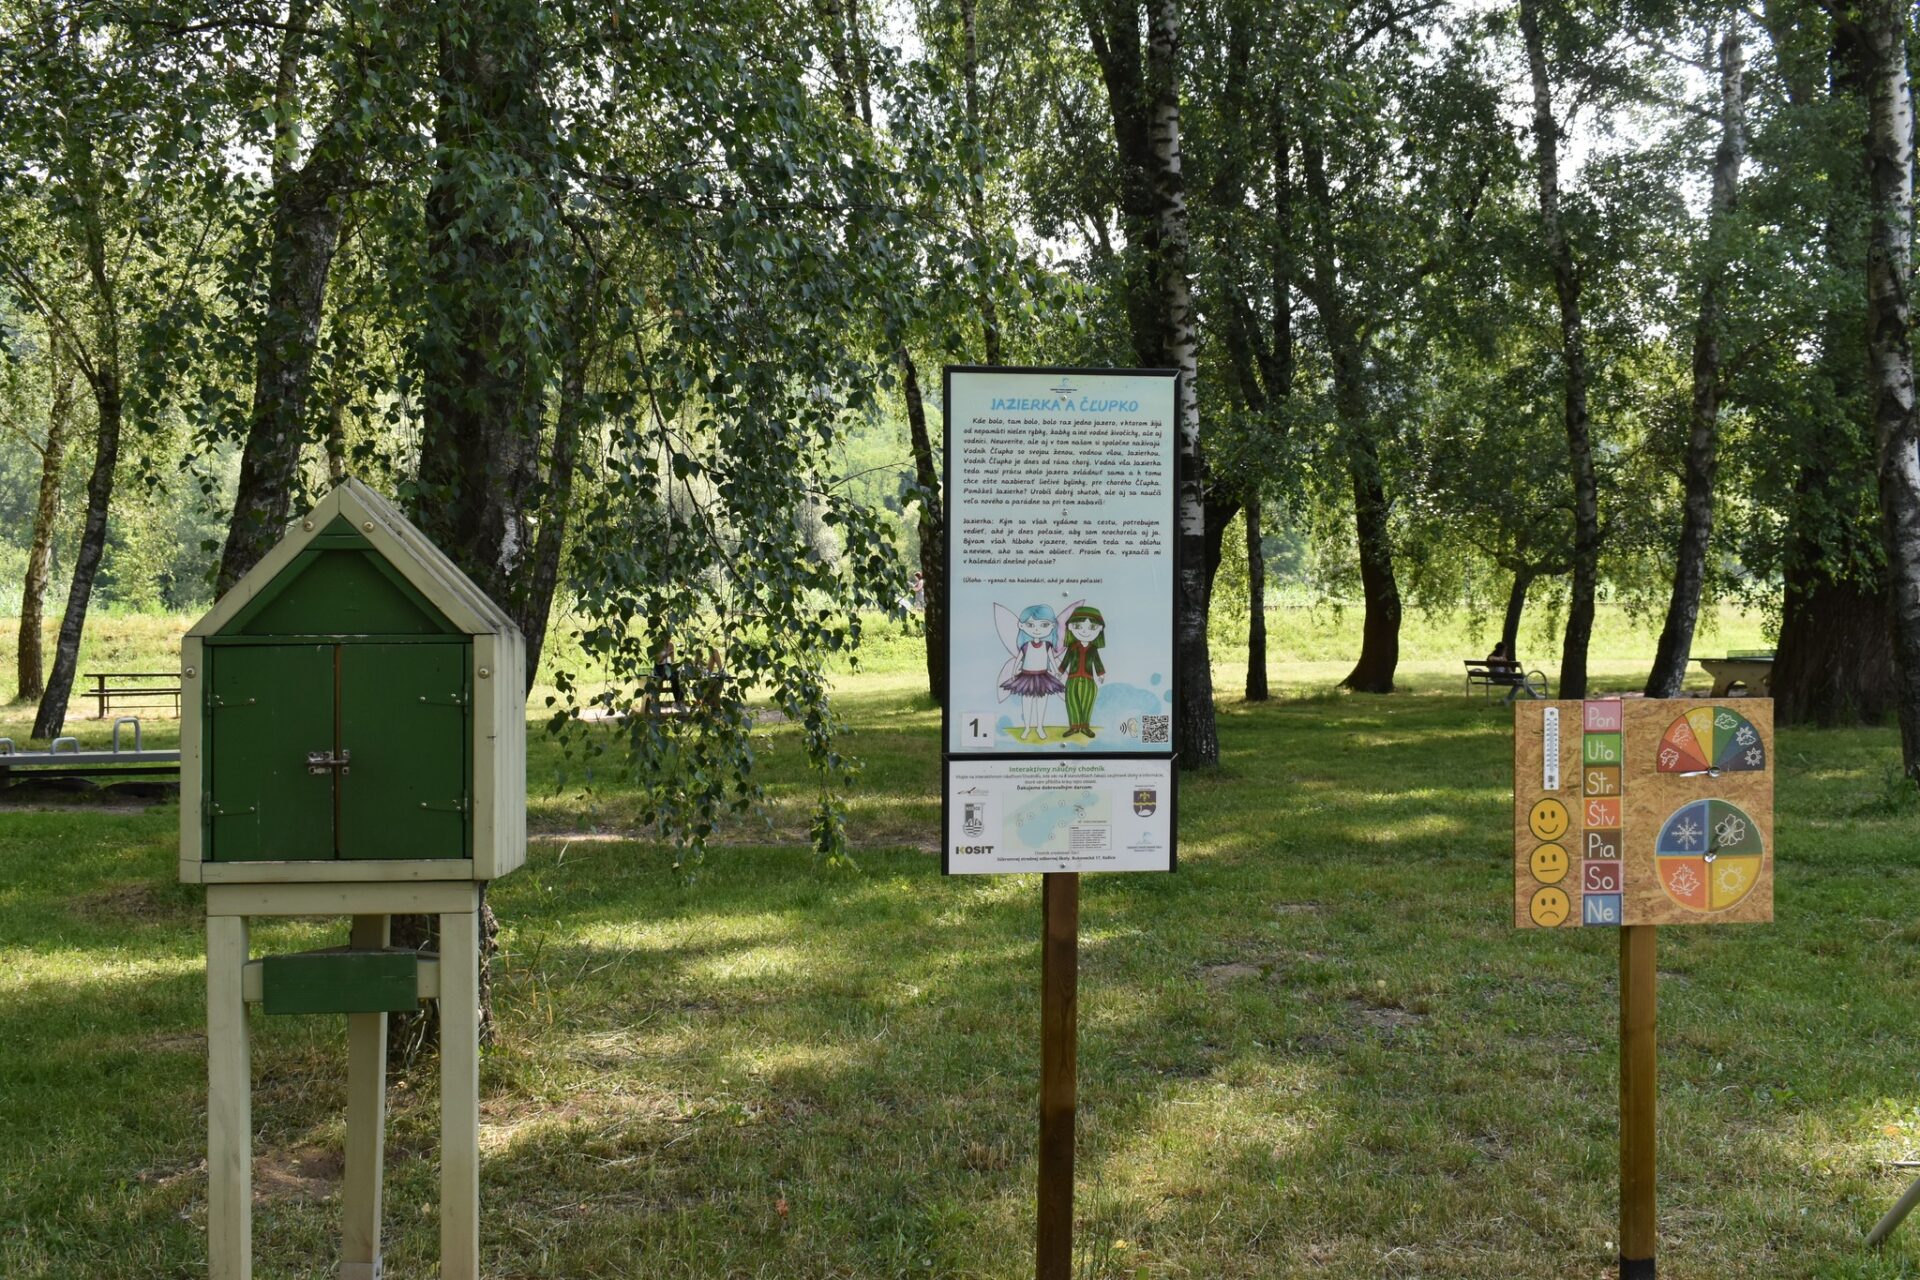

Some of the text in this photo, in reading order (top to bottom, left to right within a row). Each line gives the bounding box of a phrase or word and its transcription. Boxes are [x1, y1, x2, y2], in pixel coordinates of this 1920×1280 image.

[991, 396, 1139, 412] JAZIERKA A ČĽUPKO
[969, 718, 987, 737] 1.
[1588, 706, 1615, 727] Pon
[1588, 740, 1614, 760] Uto
[1587, 771, 1613, 795] Str
[1587, 800, 1615, 827] Štv
[956, 846, 994, 854] KOSIT
[1588, 833, 1615, 858] Pia
[1587, 866, 1614, 890] So
[1587, 899, 1613, 923] Ne
